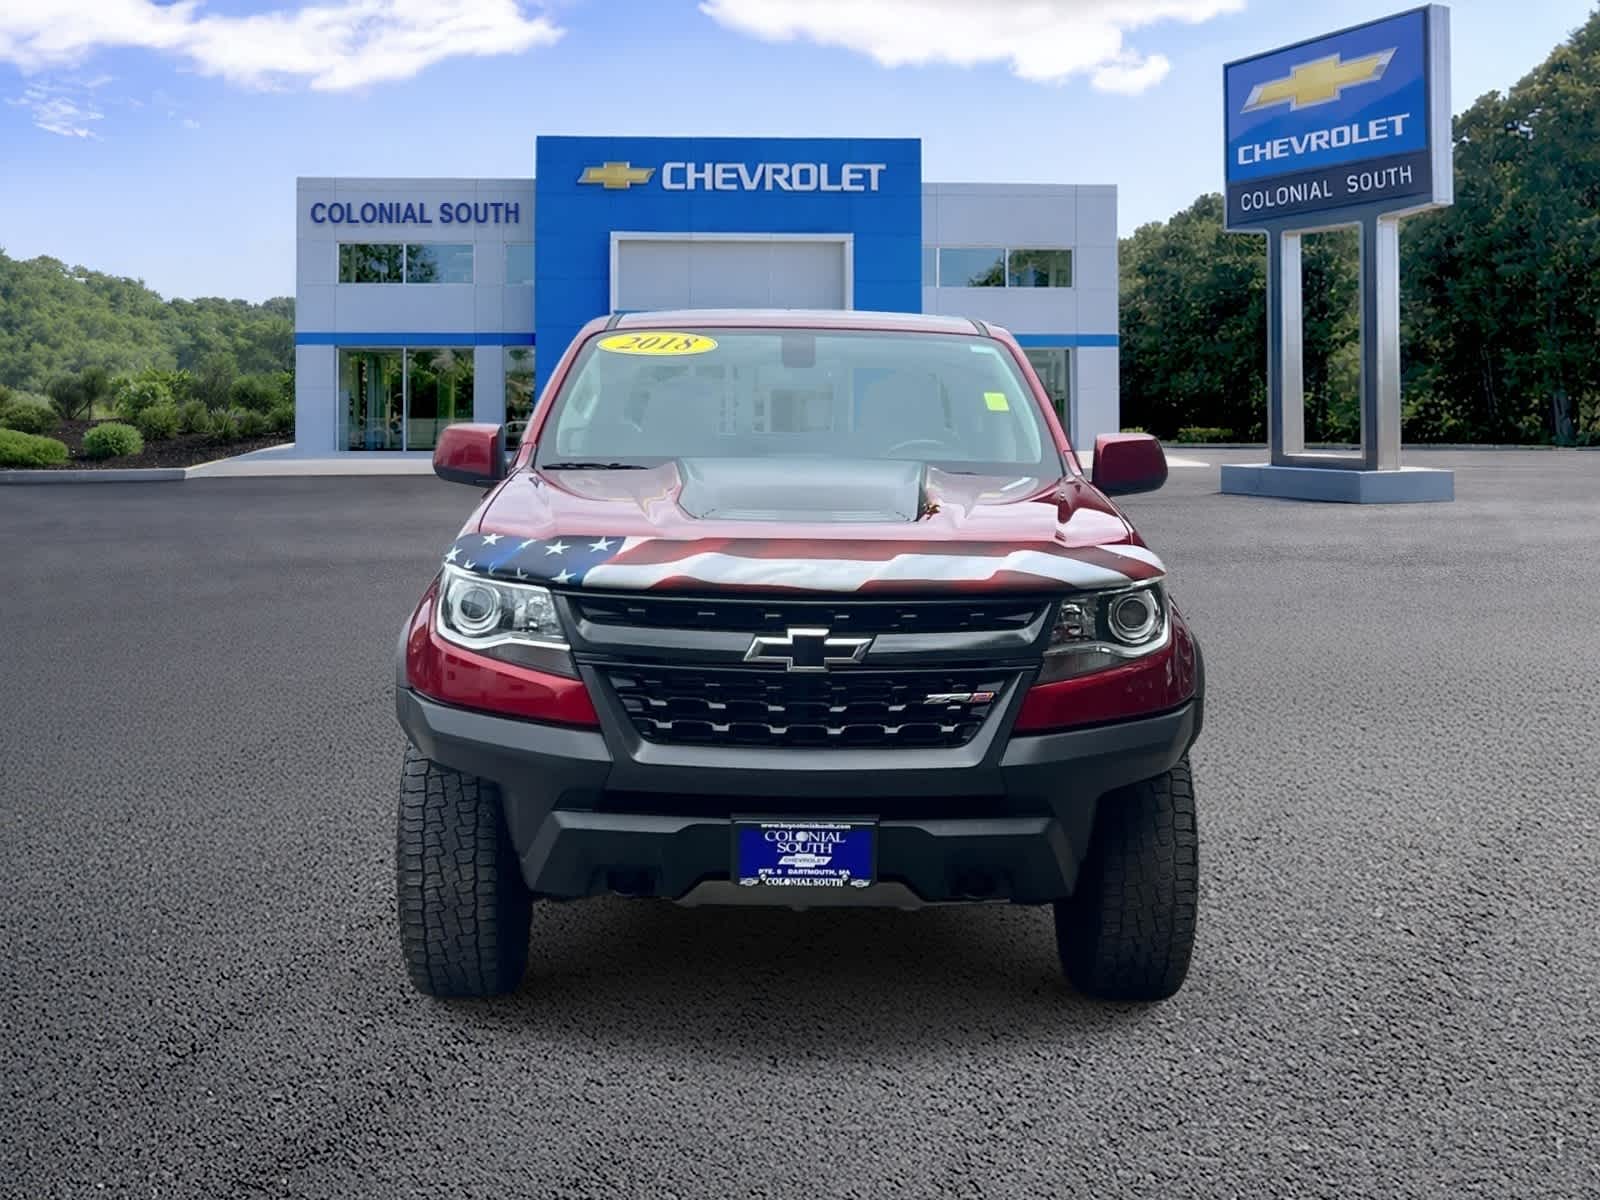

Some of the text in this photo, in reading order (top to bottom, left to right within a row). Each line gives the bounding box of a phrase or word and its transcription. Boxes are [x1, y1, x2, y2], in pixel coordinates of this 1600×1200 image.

[1238, 113, 1410, 165] CHEVROLET
[662, 162, 887, 191] CHEVROLET
[1241, 165, 1413, 211] COLONIAL SOUTH
[311, 202, 520, 225] COLONIAL SOUTH
[615, 336, 699, 350] 2018
[765, 830, 845, 842] COLONIAL
[777, 842, 832, 854] SOUTH
[765, 877, 843, 888] COLONIAL SOUTH
